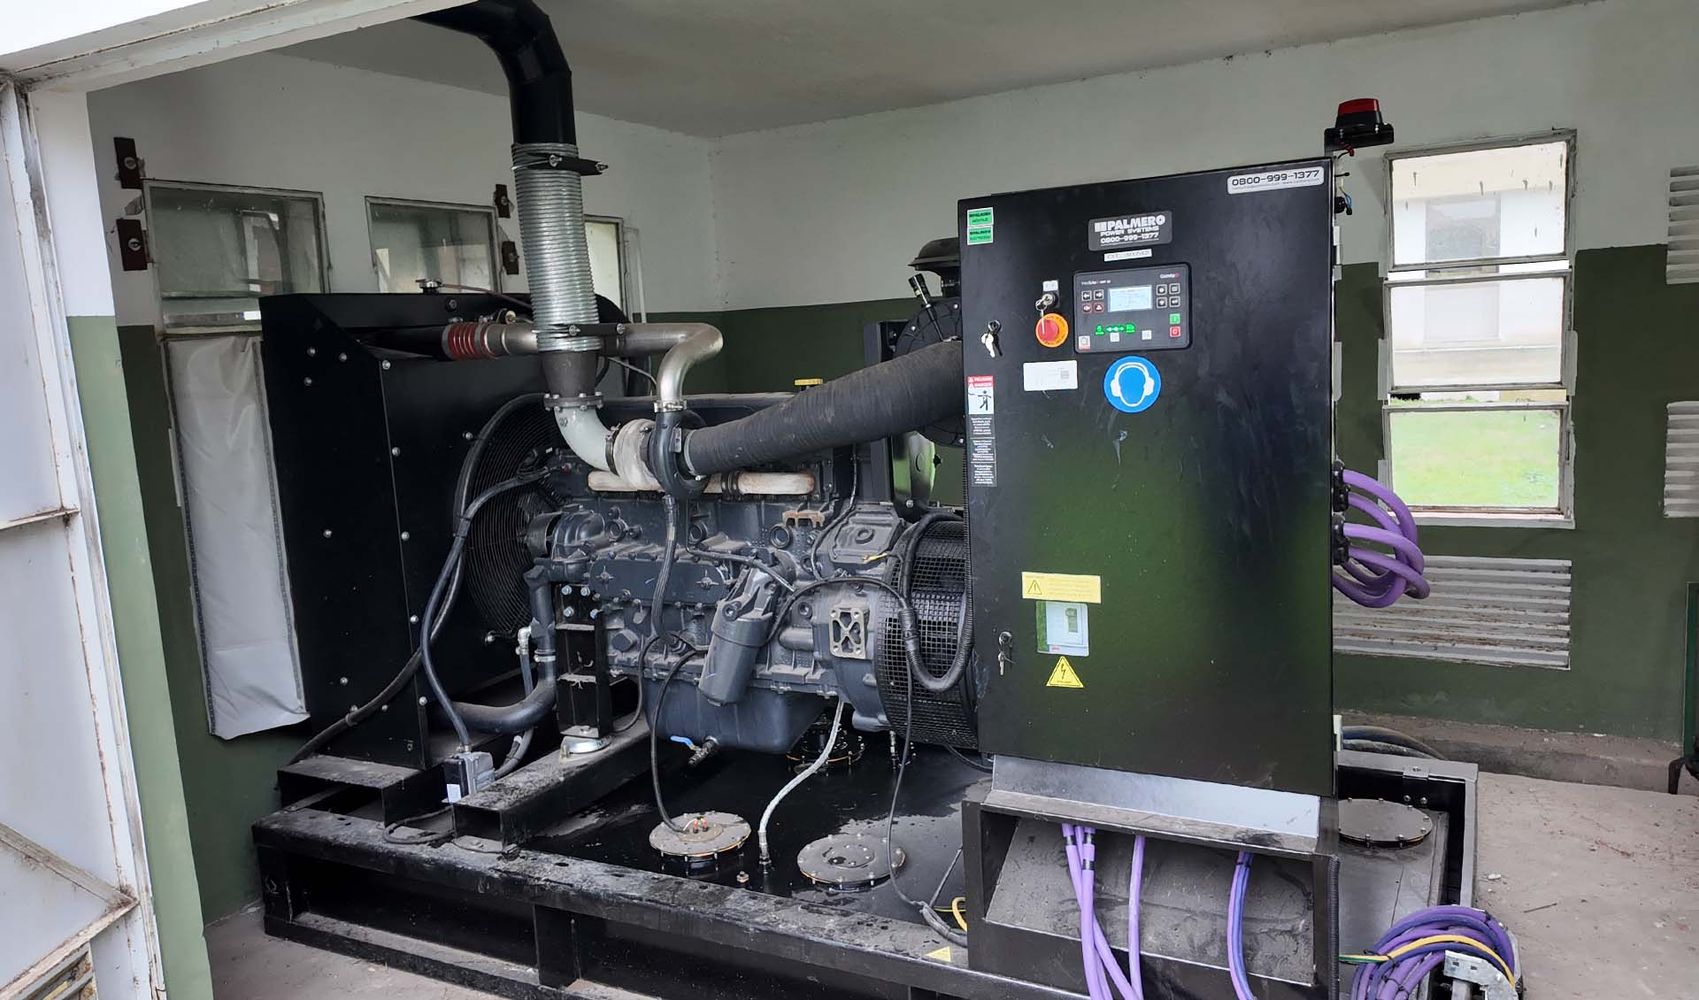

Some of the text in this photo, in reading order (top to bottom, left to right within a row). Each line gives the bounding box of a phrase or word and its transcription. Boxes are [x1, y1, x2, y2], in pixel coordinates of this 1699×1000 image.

[1232, 169, 1320, 187] 0800-999-1377
[1107, 214, 1165, 231] PALMERO
[1100, 225, 1159, 237] POWER SYSTEMS
[1100, 232, 1159, 243] 0800-999-1377
